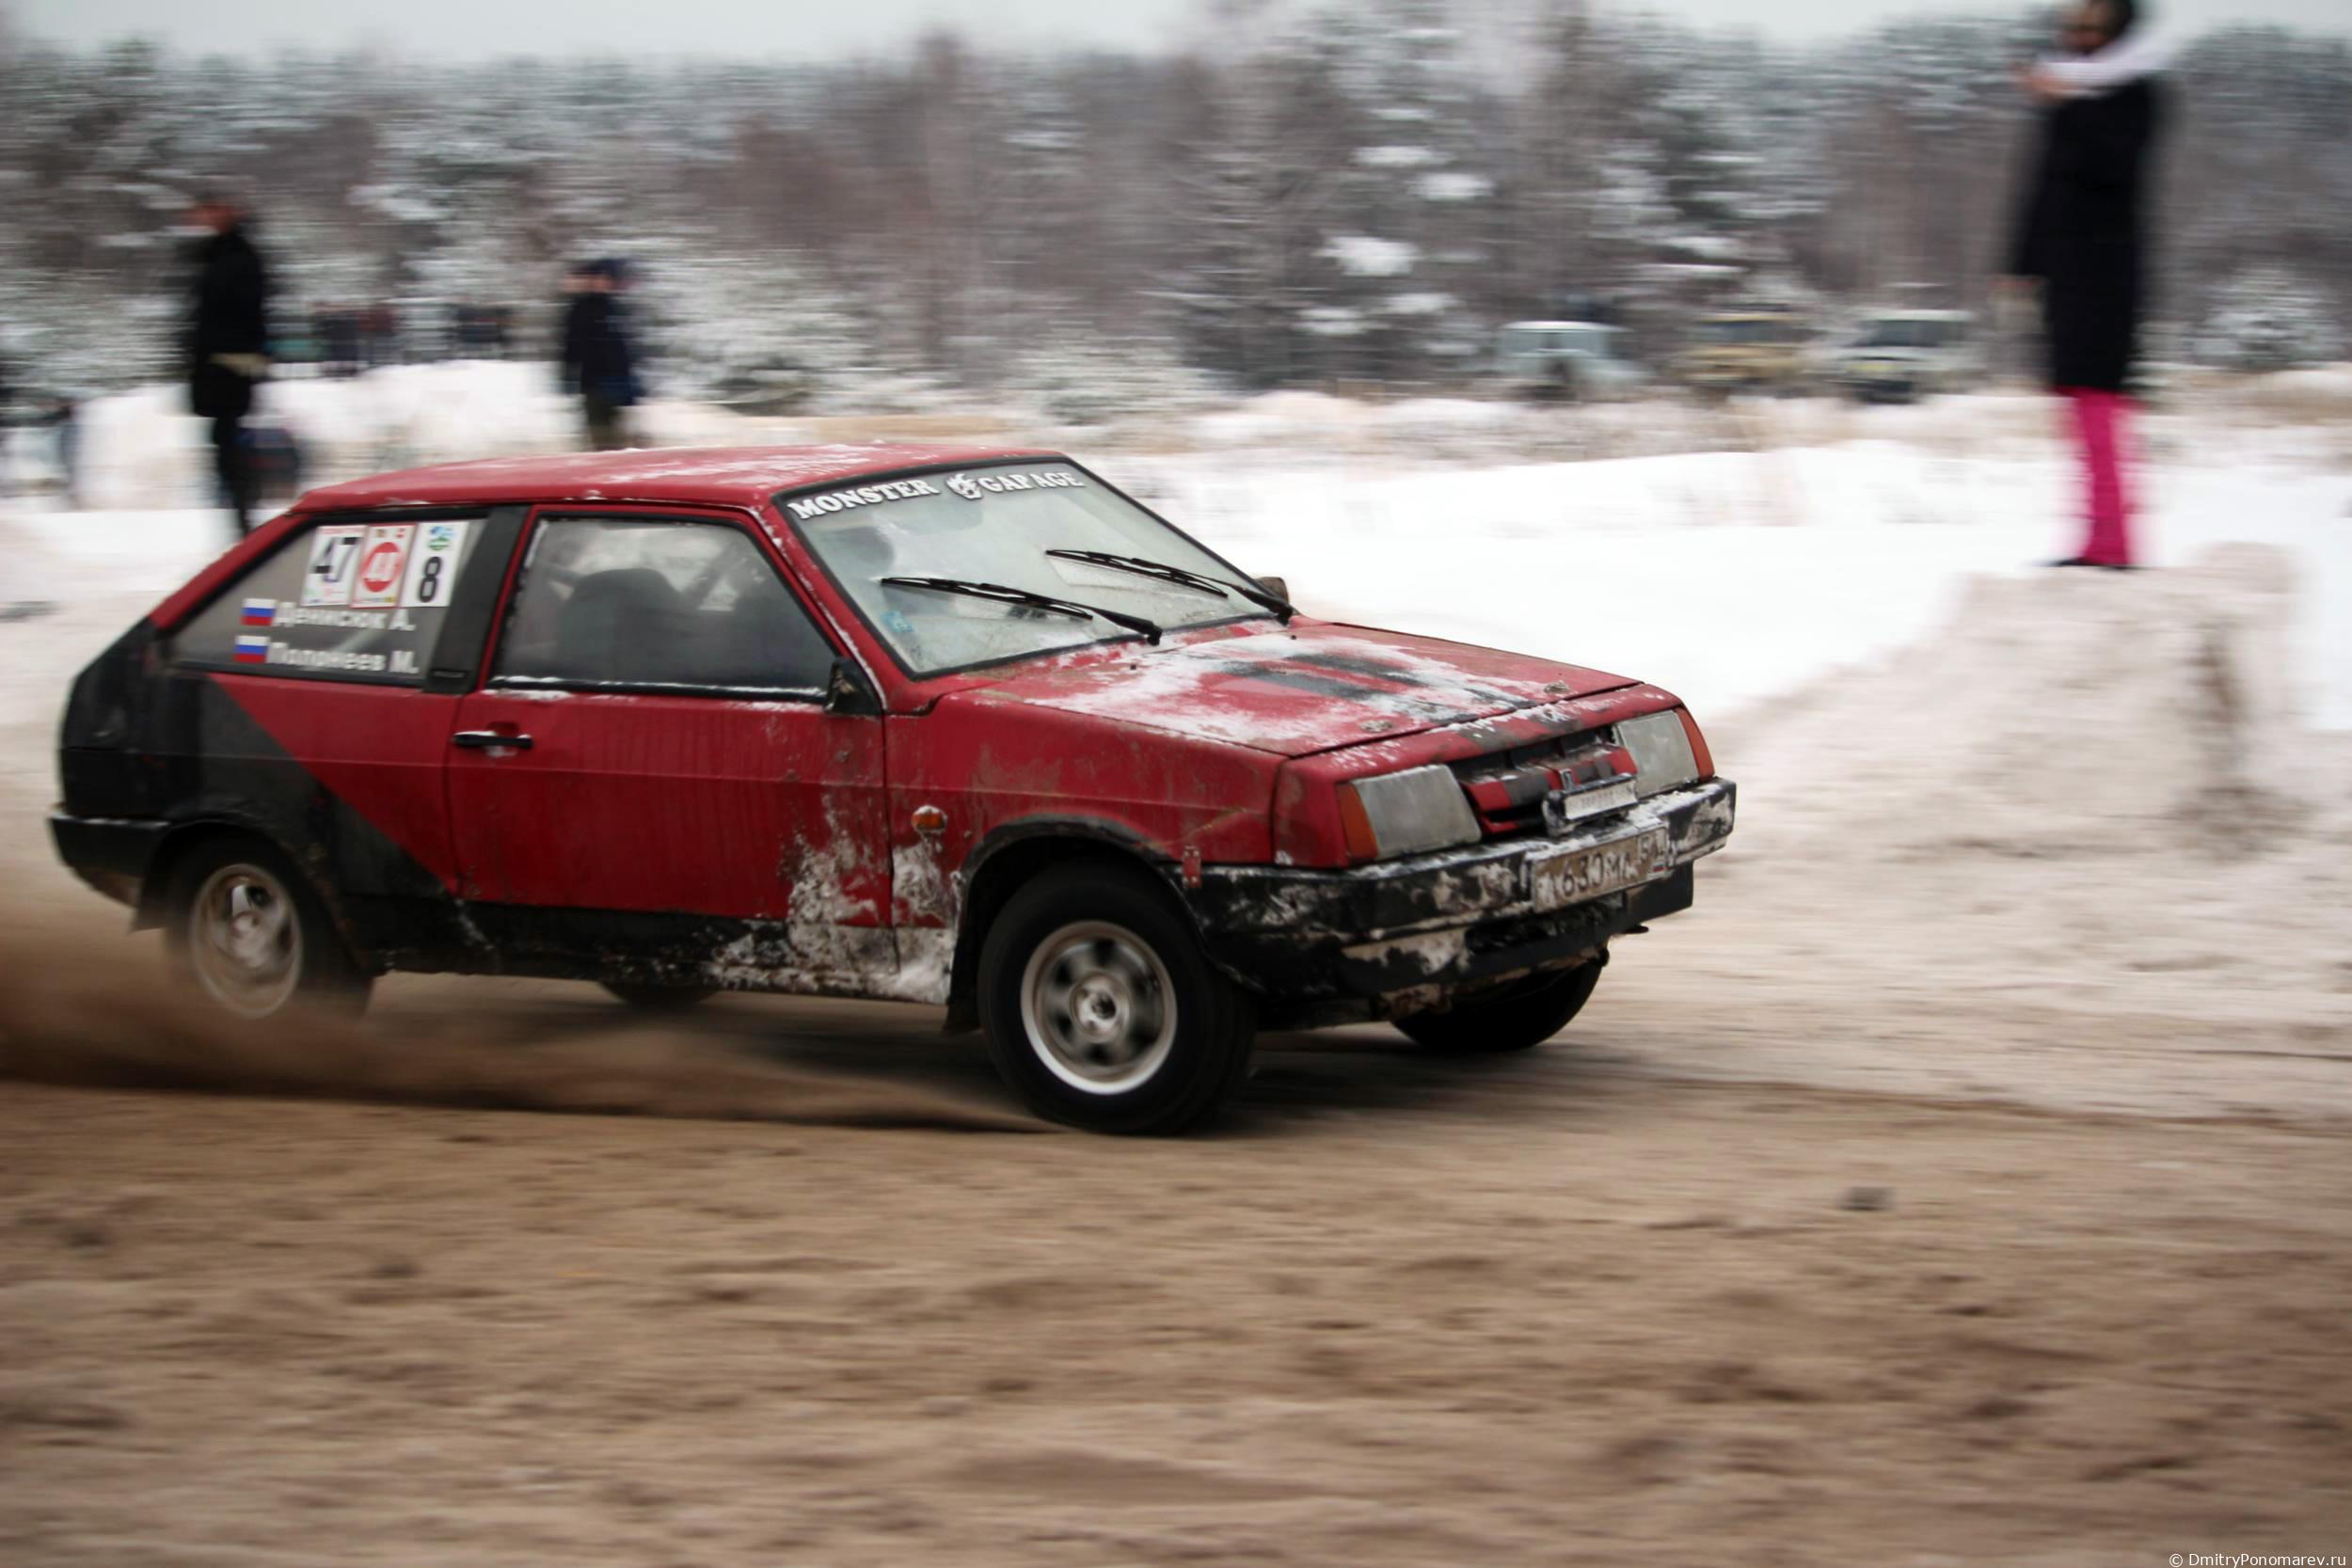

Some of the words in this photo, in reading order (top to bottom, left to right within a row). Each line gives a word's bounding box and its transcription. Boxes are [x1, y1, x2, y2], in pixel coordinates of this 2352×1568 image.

[787, 479, 940, 519] MONSTER
[978, 472, 1085, 492] GARAGE
[310, 536, 361, 583] 47
[419, 556, 442, 603] 8
